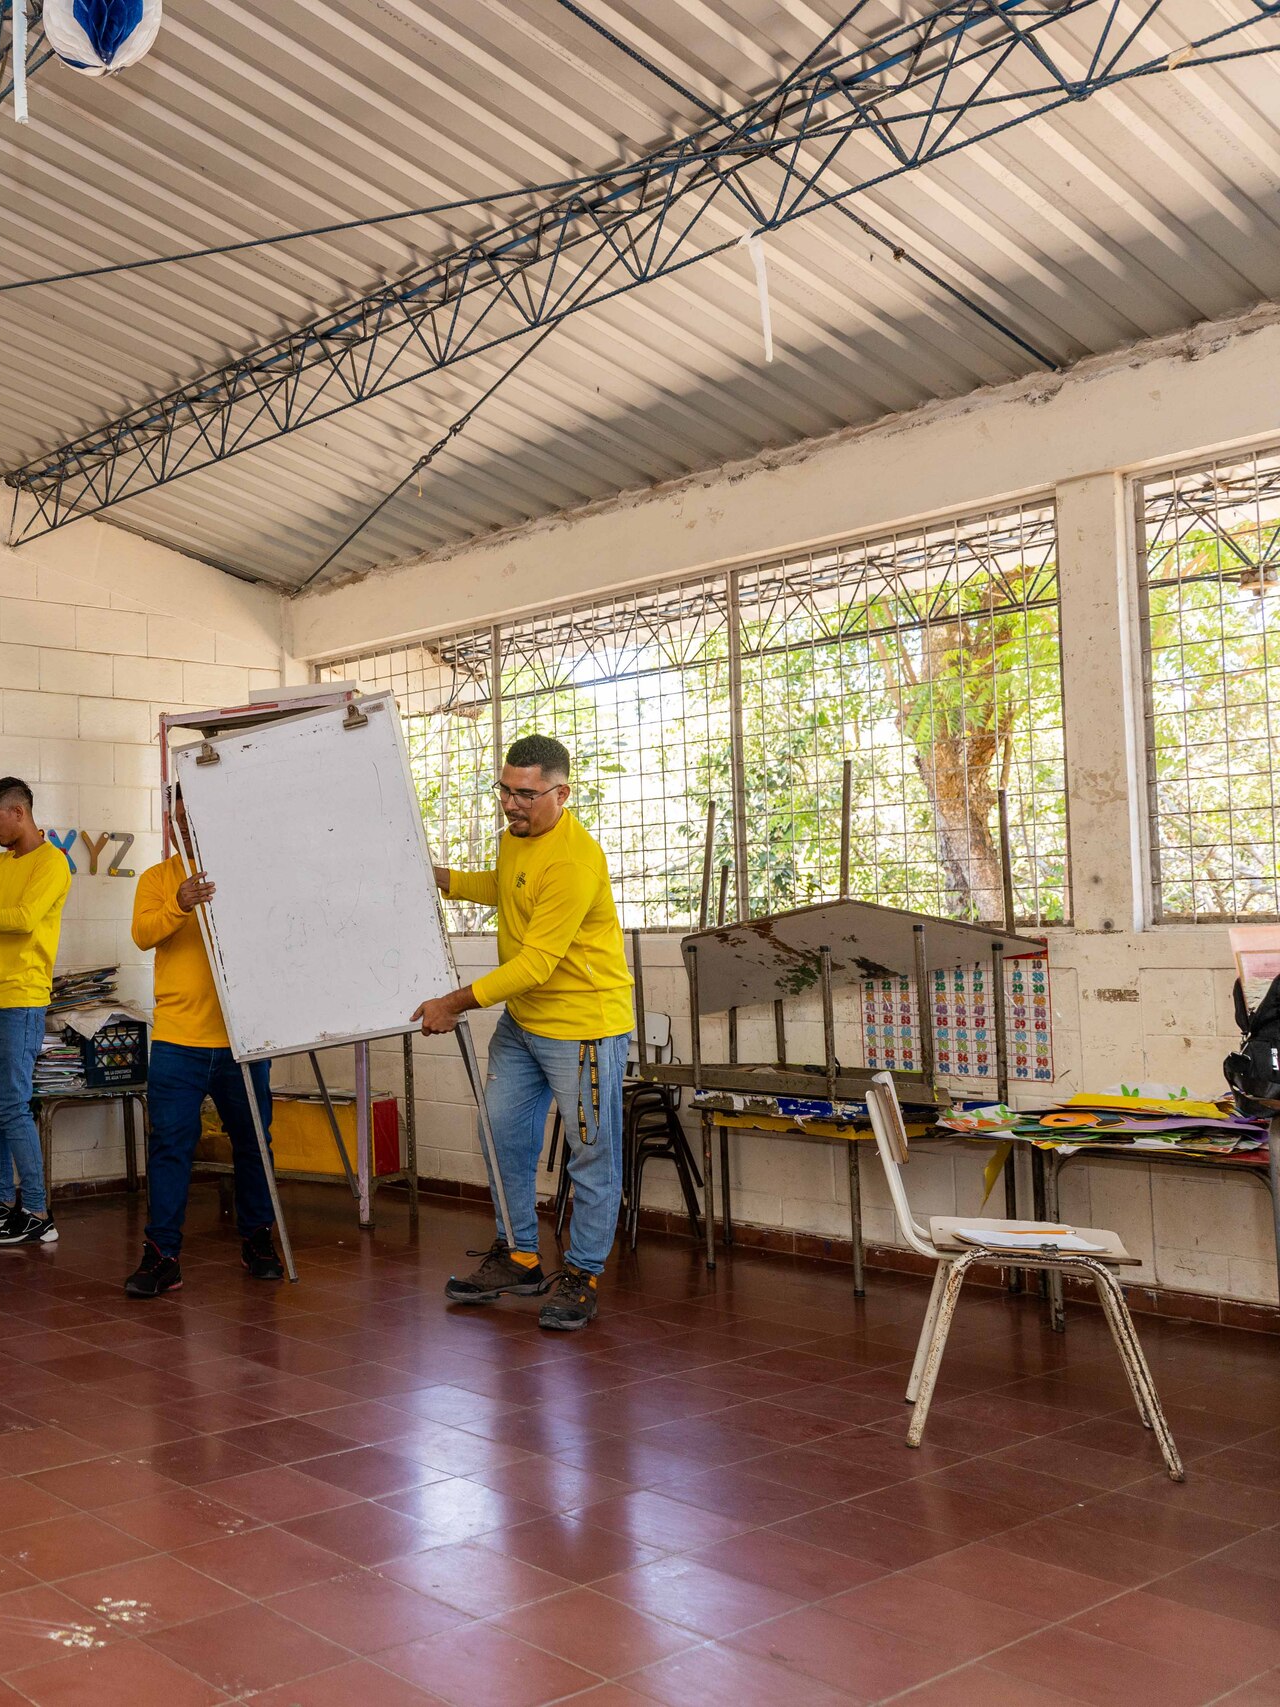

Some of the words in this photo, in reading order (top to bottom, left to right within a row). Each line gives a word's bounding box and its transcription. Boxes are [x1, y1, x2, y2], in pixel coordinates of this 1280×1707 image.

[81, 830, 110, 876] Y
[110, 833, 136, 877] Z
[882, 981, 891, 990] 22
[900, 982, 909, 990] 23
[935, 982, 945, 991] 25
[954, 982, 964, 991] 26
[973, 983, 983, 991] 27
[1012, 984, 1023, 993] 29
[1033, 985, 1044, 993] 30
[867, 1014, 875, 1023] 51
[884, 1015, 893, 1023] 52
[901, 1015, 910, 1024] 53
[937, 1017, 948, 1026] 55
[956, 1017, 966, 1026] 56
[975, 1019, 985, 1027] 57
[1015, 1020, 1025, 1029] 59
[1035, 1021, 1046, 1029] 60
[868, 1048, 877, 1057] 81
[885, 1049, 894, 1058] 82
[903, 1050, 912, 1059] 83
[939, 1052, 949, 1061] 85
[958, 1053, 968, 1063] 86
[977, 1054, 987, 1063] 87
[1016, 1056, 1027, 1065] 89
[1036, 1057, 1048, 1066] 90
[868, 1059, 877, 1067] 91
[885, 1060, 895, 1069] 92
[903, 1061, 913, 1070] 93
[939, 1063, 950, 1072] 95
[958, 1064, 969, 1074] 96
[978, 1065, 988, 1075] 97
[1016, 1068, 1028, 1077] 99
[1035, 1069, 1050, 1079] 100
